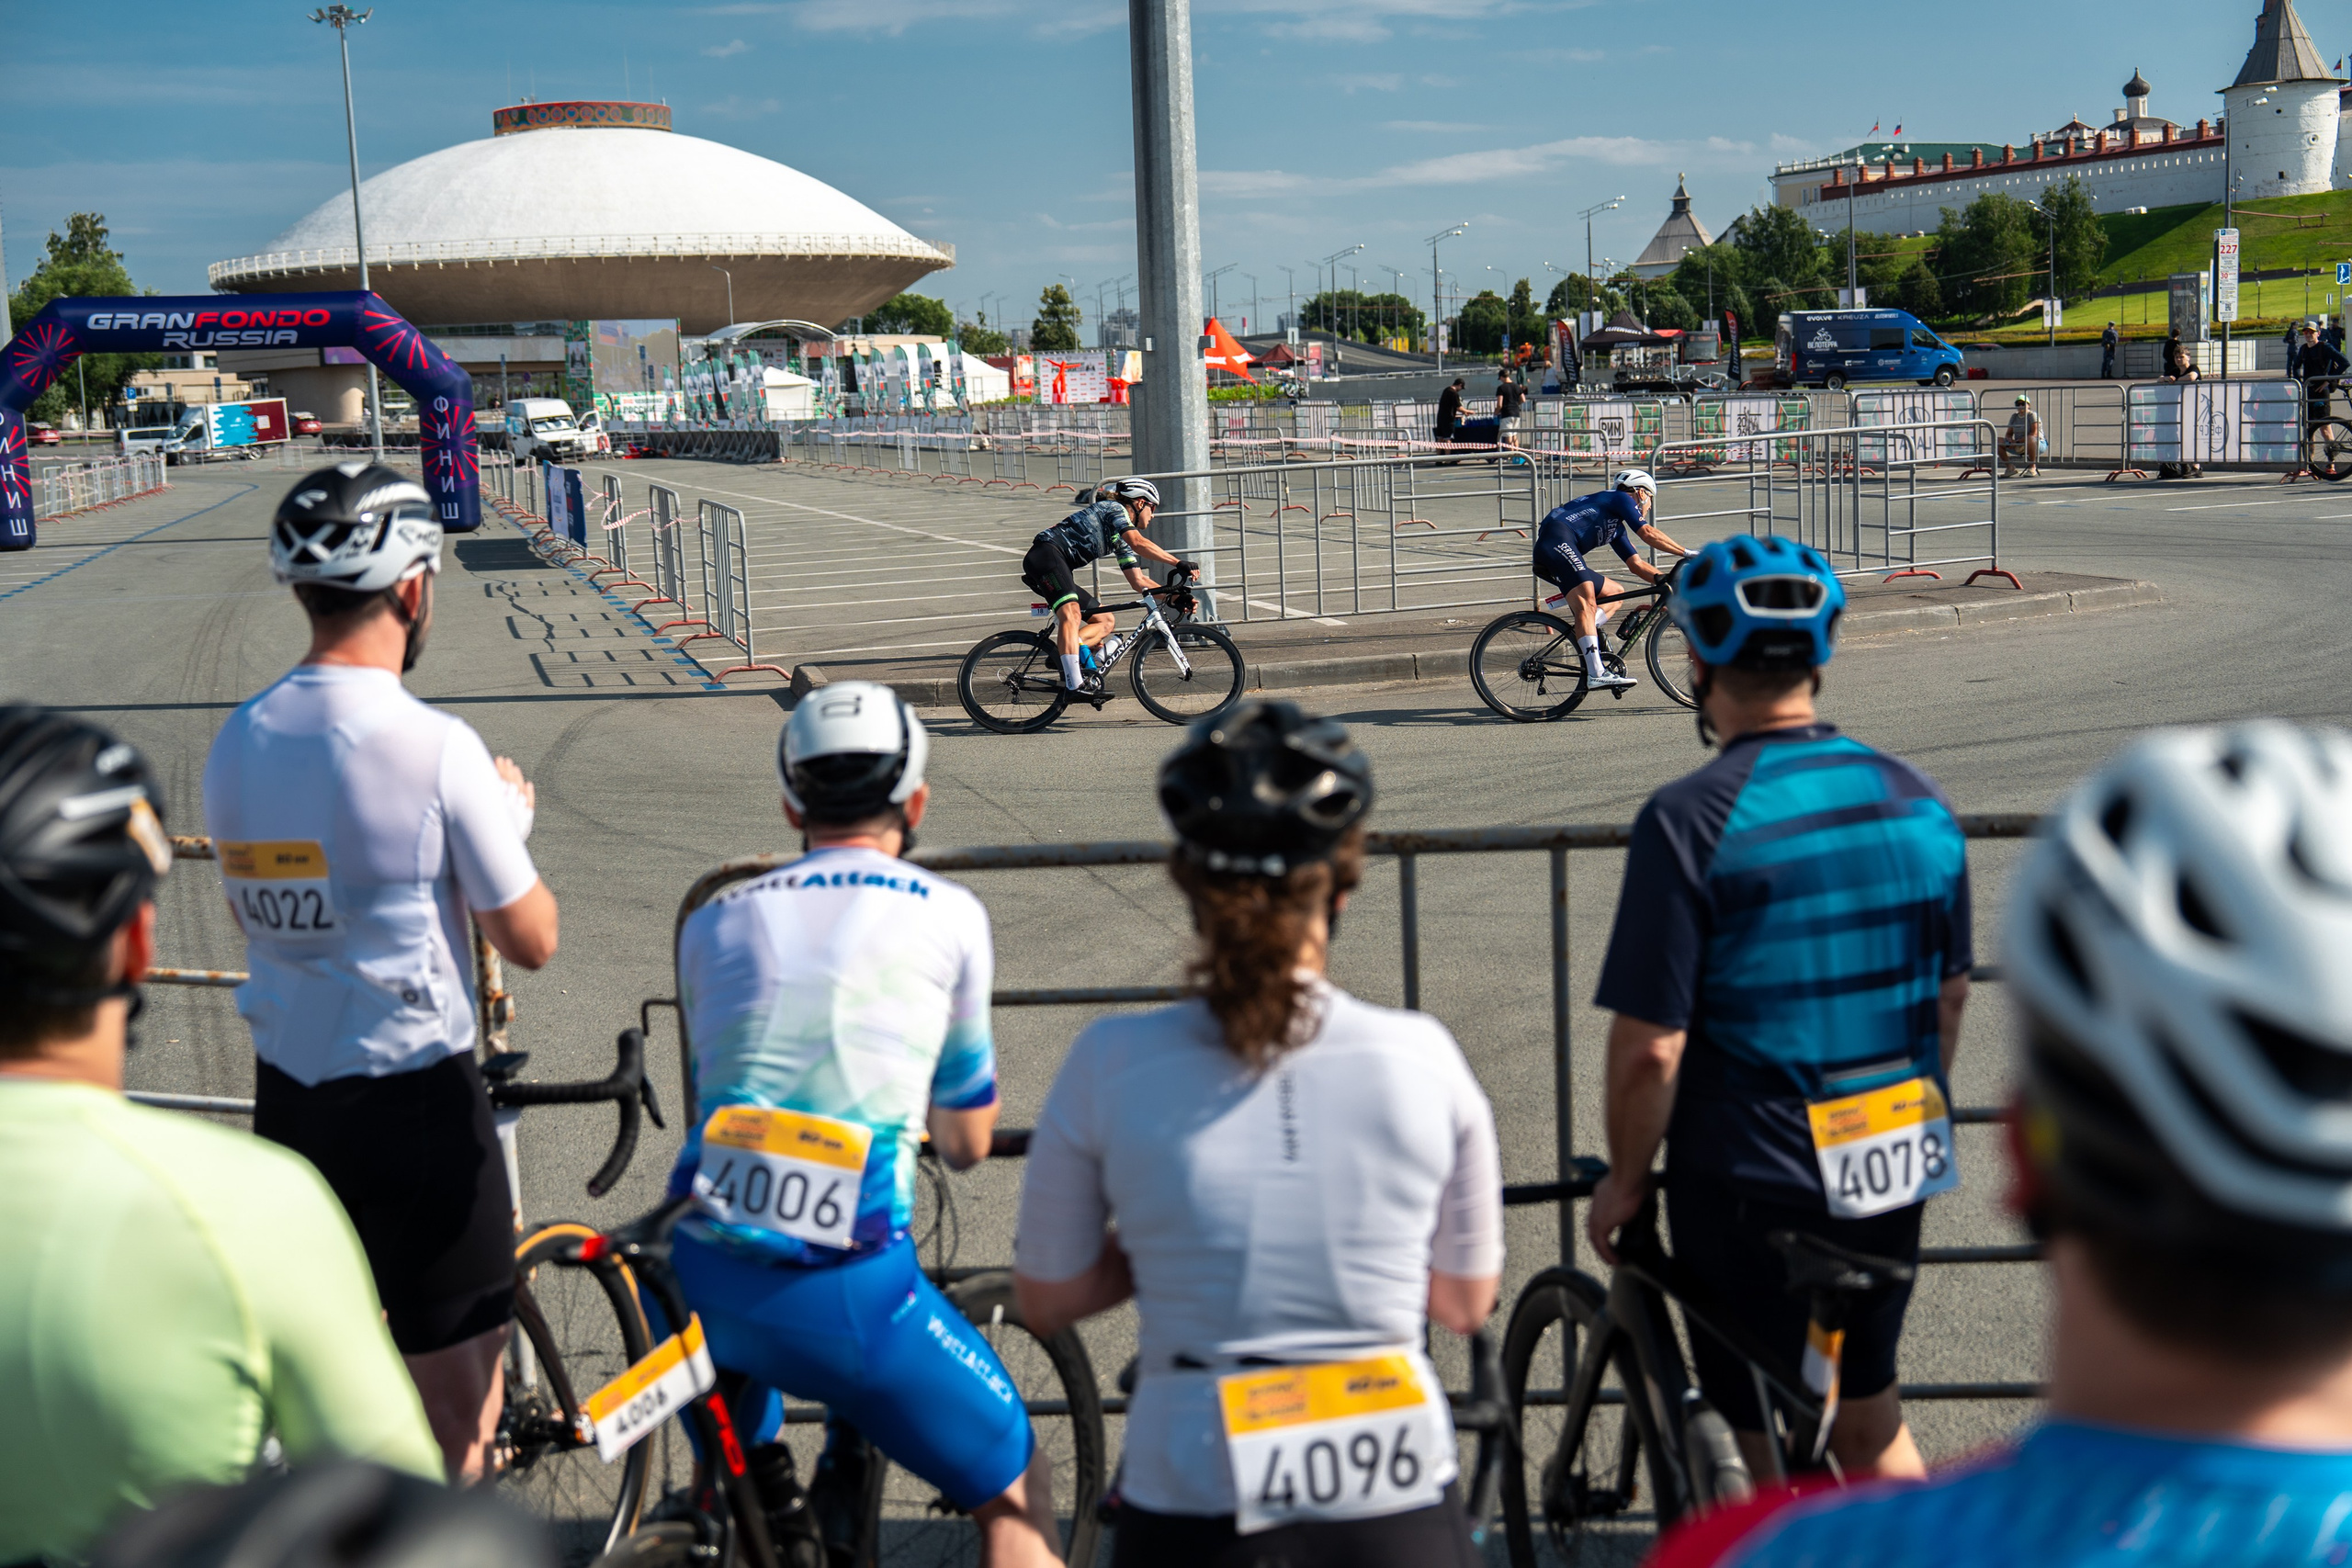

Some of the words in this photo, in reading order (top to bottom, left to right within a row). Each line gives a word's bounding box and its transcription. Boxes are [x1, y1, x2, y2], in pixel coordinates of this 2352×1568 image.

[2220, 244, 2238, 254] 227
[162, 330, 299, 349] RUSSIA
[1806, 341, 1838, 350] ВЕЛОТЕРРА
[0, 412, 28, 536] ИНИШ
[434, 395, 459, 520] ФИНИШ
[1566, 507, 1597, 523] SERPANTIN
[1557, 542, 1587, 571] SERPANTIN
[1098, 624, 1145, 675] COLNAGO
[242, 886, 334, 931] 4022
[1839, 1132, 1948, 1201] 4078
[707, 1157, 843, 1230] 4006
[615, 1381, 669, 1435] 4006
[1261, 1424, 1420, 1509] 4096
